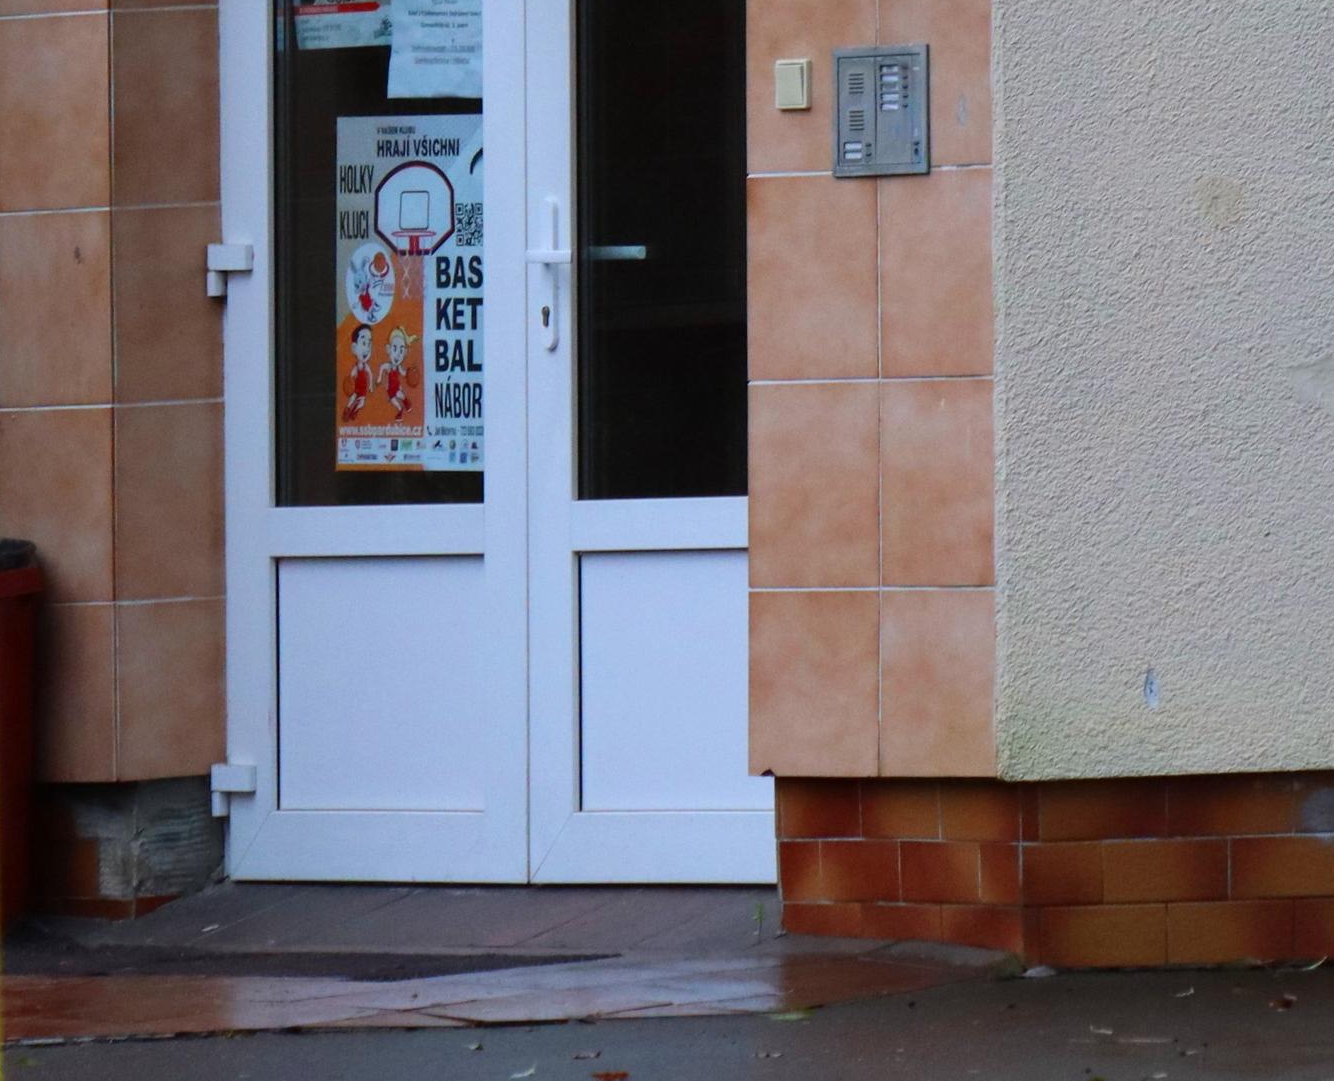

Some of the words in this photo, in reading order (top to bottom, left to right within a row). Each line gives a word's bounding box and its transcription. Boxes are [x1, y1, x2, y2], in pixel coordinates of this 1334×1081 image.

[376, 135, 410, 157] HRAJÍ
[413, 134, 460, 157] VŠICHNI
[339, 164, 374, 194] HOLKY
[339, 210, 369, 240] KLUCI
[435, 255, 484, 289] BAS
[435, 297, 484, 331] KET
[434, 339, 483, 373] BAL
[434, 375, 483, 419] NÁBOR
